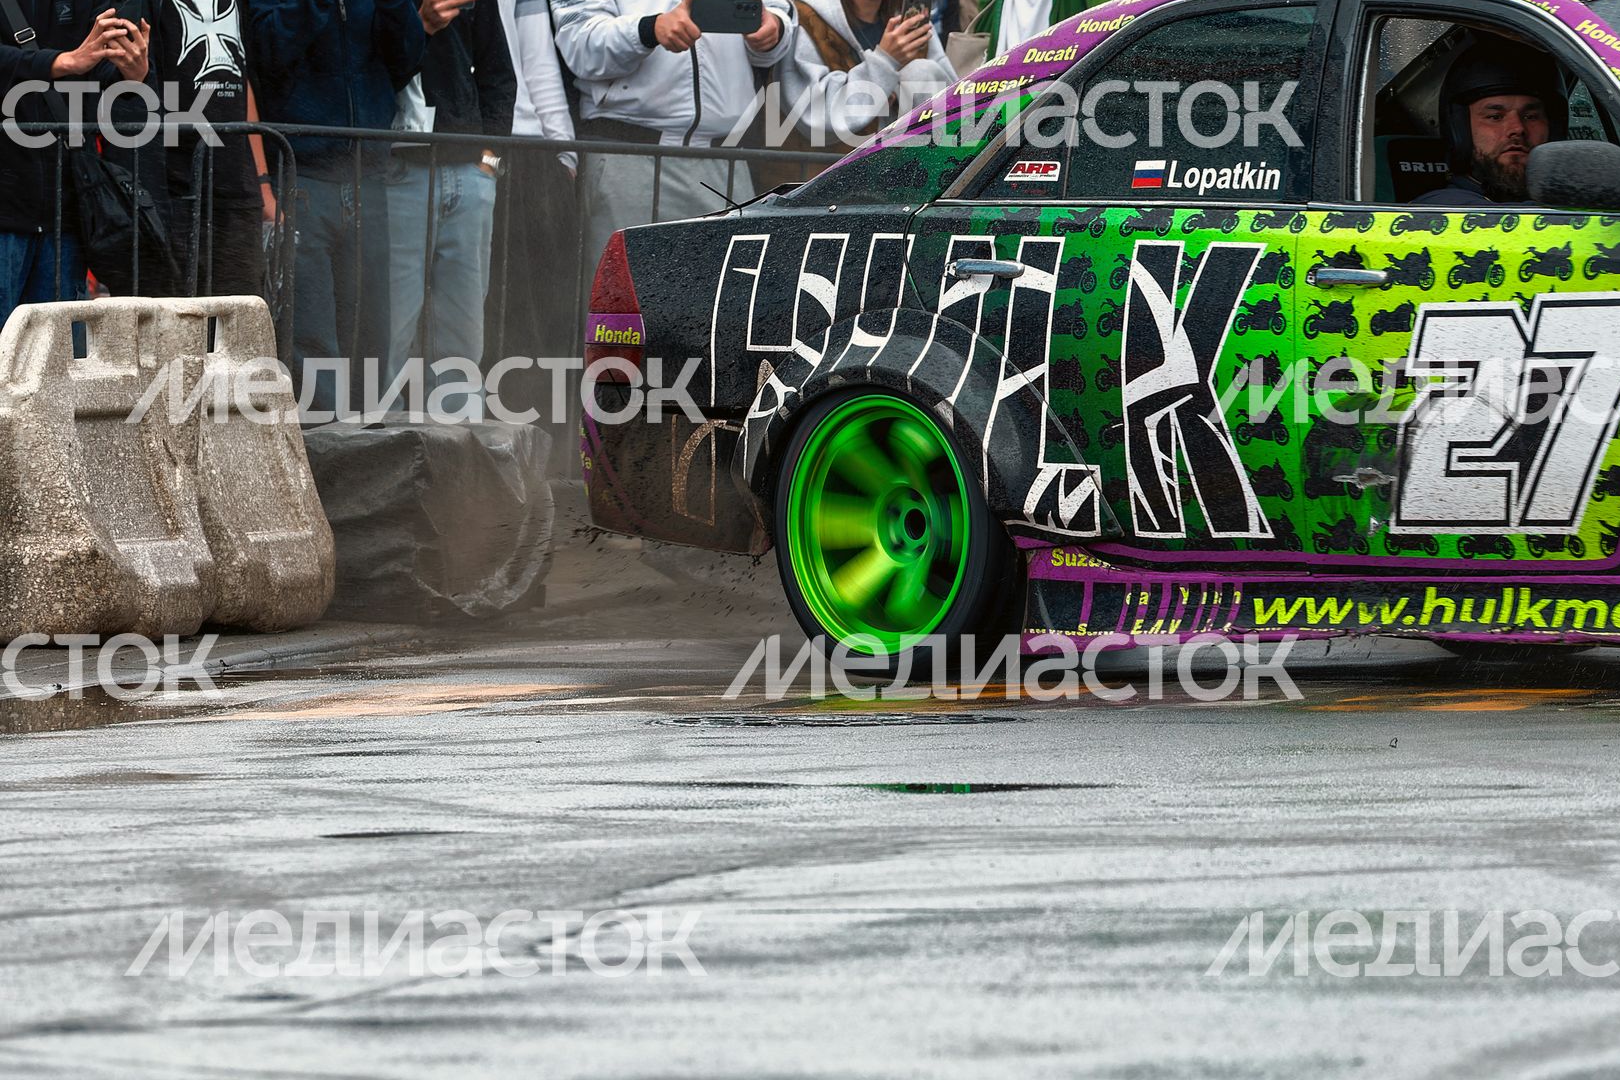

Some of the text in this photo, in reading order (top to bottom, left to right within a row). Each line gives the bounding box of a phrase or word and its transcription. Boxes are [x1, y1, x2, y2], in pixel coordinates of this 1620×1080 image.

[1023, 45, 1078, 64] Ducati
[1009, 163, 1058, 174] ARP
[1167, 160, 1281, 195] Lopatkin
[595, 324, 641, 346] Honda
